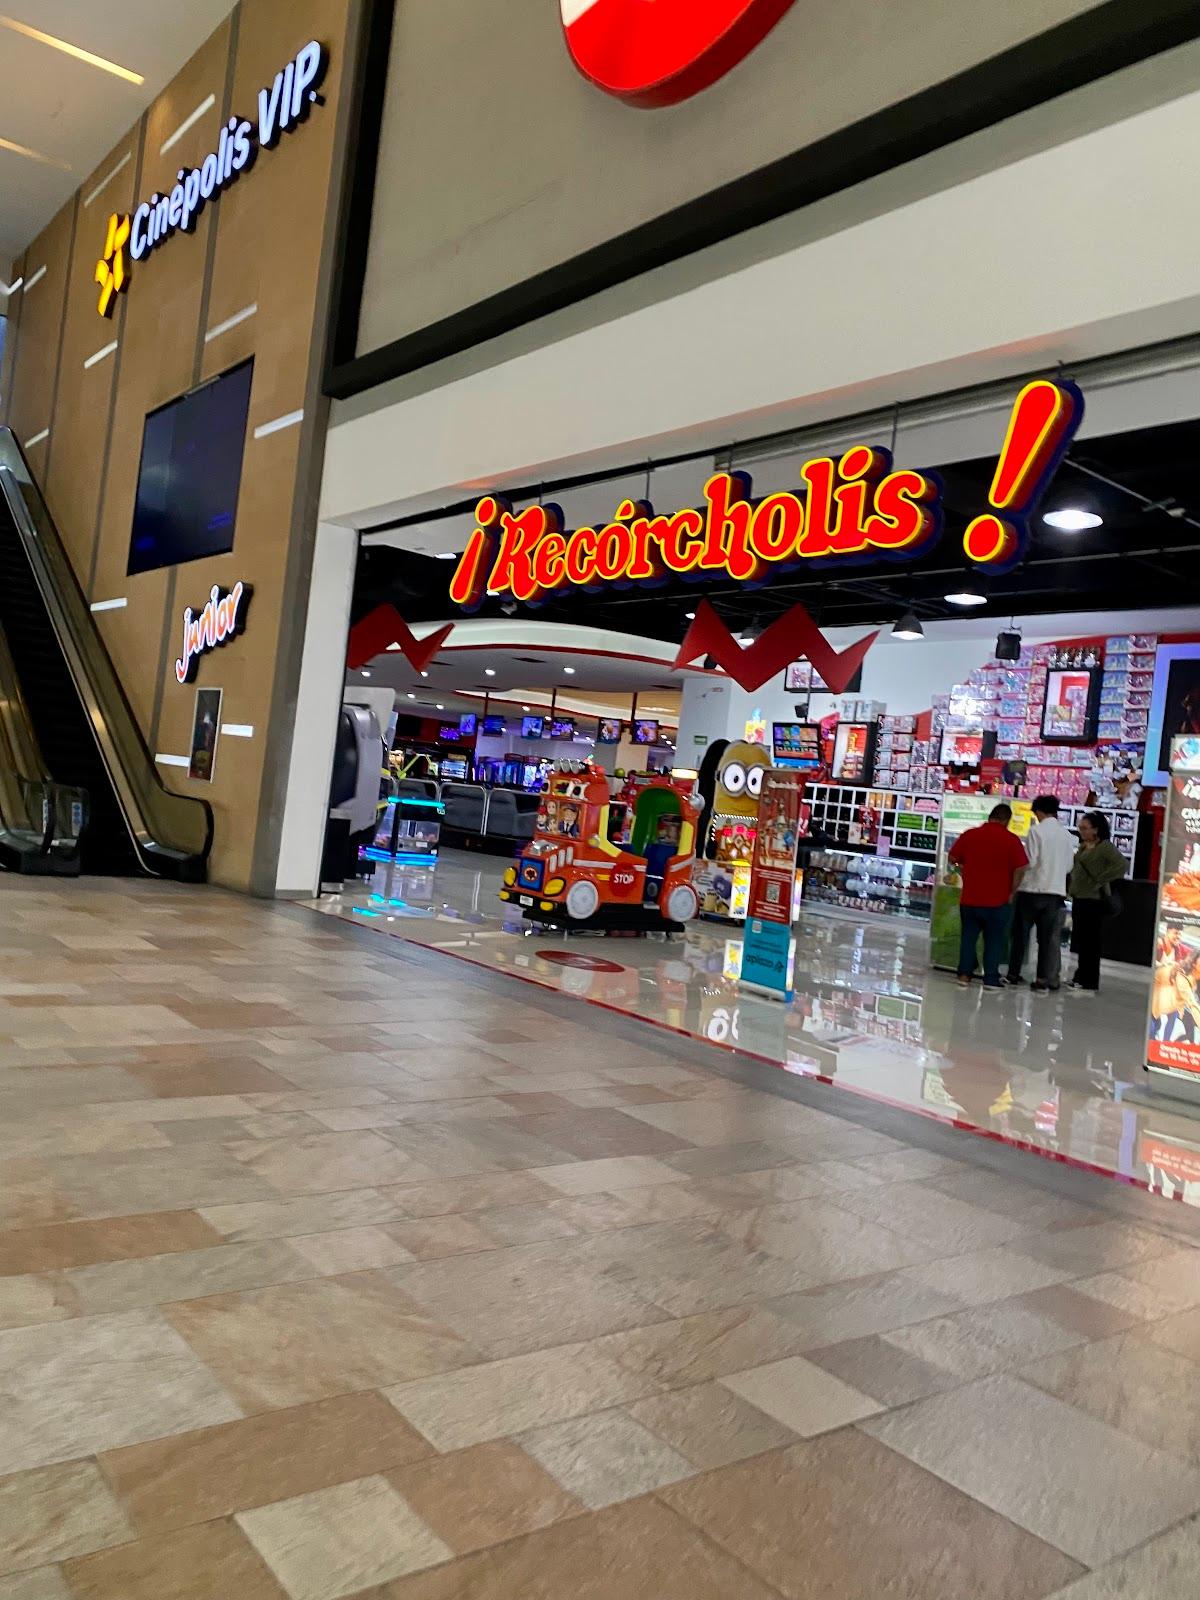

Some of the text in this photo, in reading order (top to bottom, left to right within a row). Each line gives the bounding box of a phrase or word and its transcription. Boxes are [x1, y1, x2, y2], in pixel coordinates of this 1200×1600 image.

[130, 116, 252, 261] Cinépolis
[175, 580, 244, 684] junior
[613, 872, 635, 885] STOP
